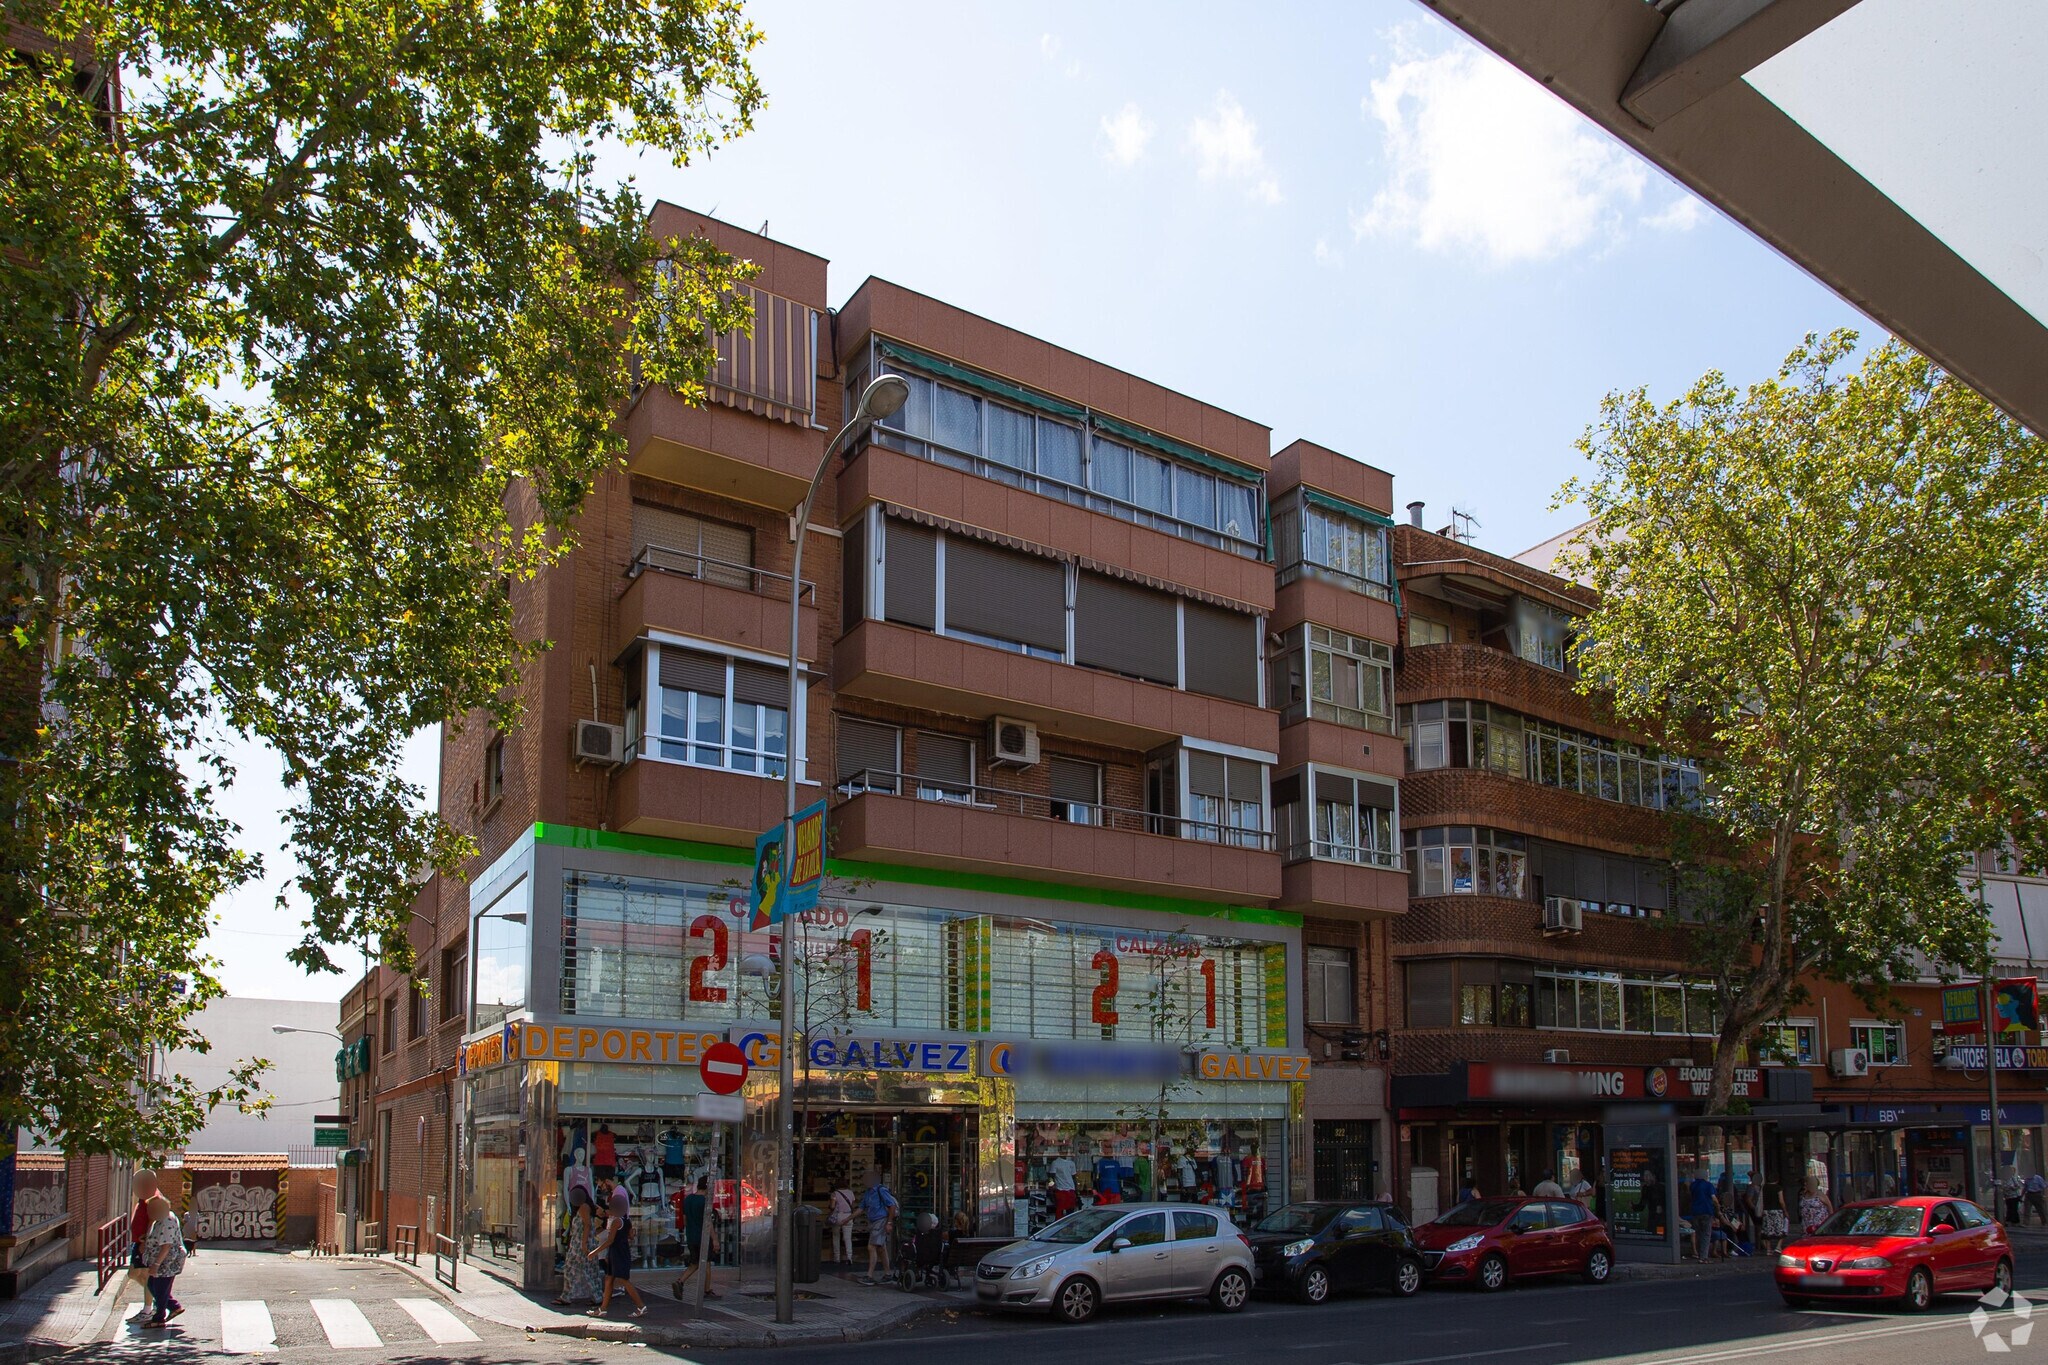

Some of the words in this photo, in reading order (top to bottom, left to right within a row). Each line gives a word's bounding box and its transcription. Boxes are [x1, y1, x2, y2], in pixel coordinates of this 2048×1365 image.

[729, 897, 849, 927] CADO
[1116, 935, 1201, 958] CALZADO
[1091, 950, 1119, 1025] 2
[810, 1039, 968, 1070] GALVEZ
[1952, 1047, 2011, 1068] AUTOESELA
[2026, 1048, 2048, 1068] TORR
[1200, 1054, 1311, 1080] GALVEZ
[1735, 1069, 1758, 1082] THE
[1691, 1082, 1749, 1096] WHER
[1980, 1108, 2007, 1121] BVA
[1613, 1177, 1641, 1189] gratis
